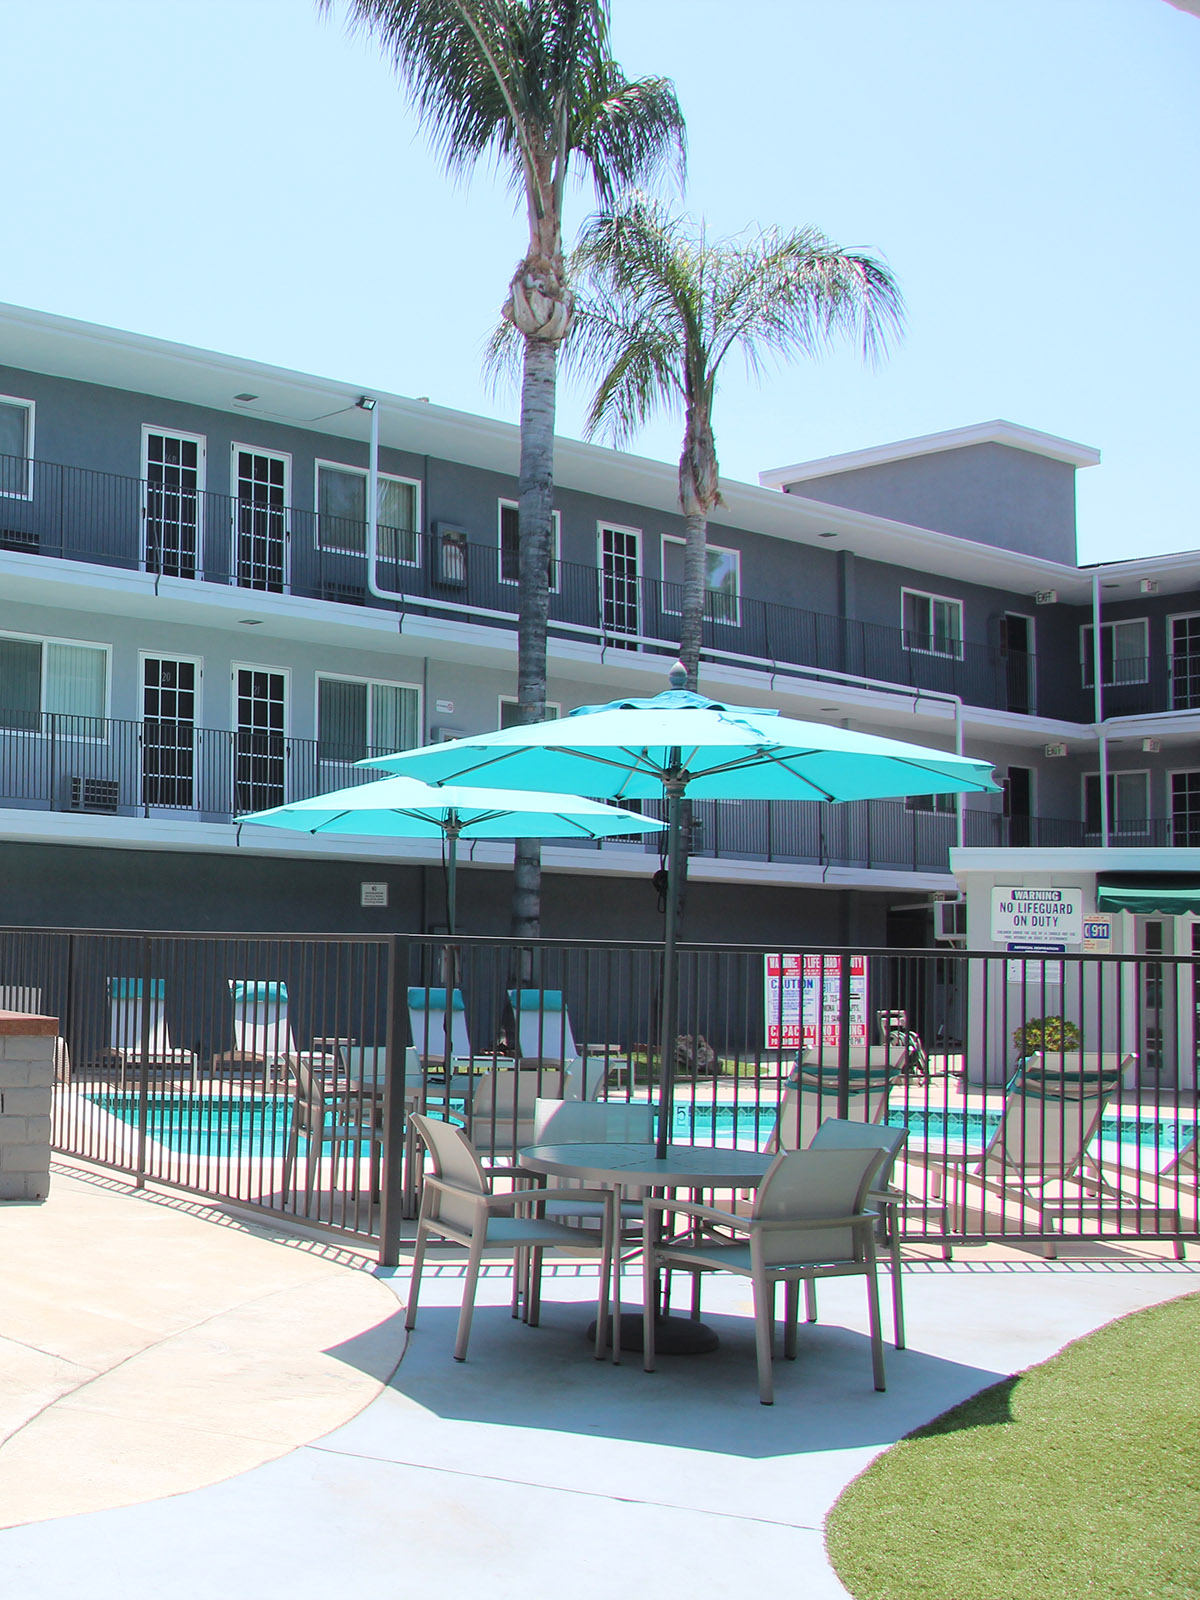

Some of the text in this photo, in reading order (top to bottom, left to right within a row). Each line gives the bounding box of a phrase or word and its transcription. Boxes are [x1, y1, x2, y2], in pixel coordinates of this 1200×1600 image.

[1013, 891, 1059, 900] WARNING
[1000, 902, 1073, 915] NO LIFEGUARD
[1013, 915, 1059, 927] ON DUTY
[1091, 925, 1107, 936] 911
[769, 957, 797, 968] WANING:
[770, 1025, 815, 1037] CPACTY
